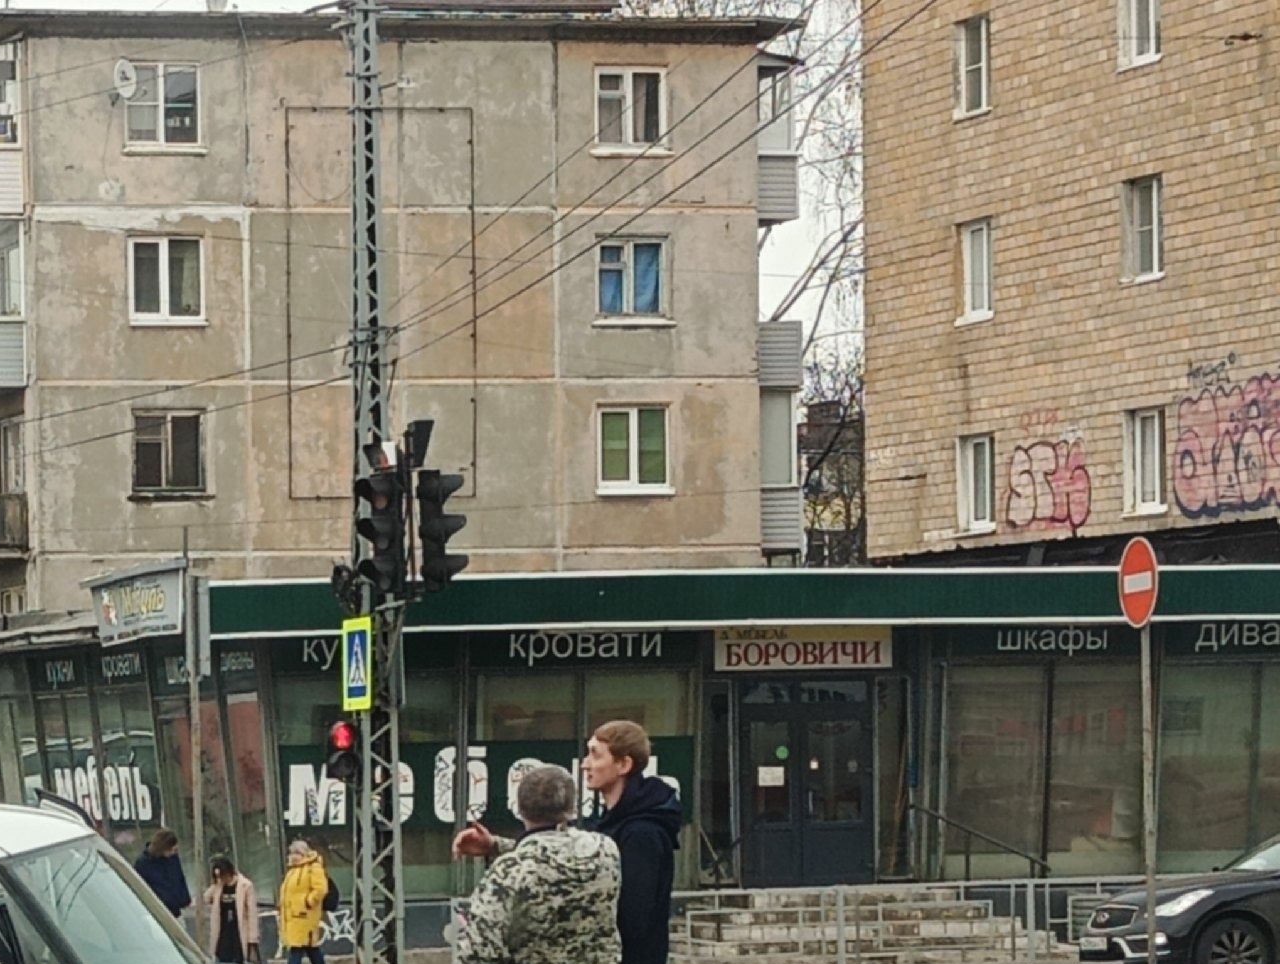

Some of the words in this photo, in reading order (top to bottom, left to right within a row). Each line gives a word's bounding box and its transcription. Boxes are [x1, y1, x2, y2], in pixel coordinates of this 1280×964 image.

[509, 631, 663, 666] кровати
[725, 640, 882, 668] БОРОВИЧИ
[997, 624, 1108, 657] шкафы
